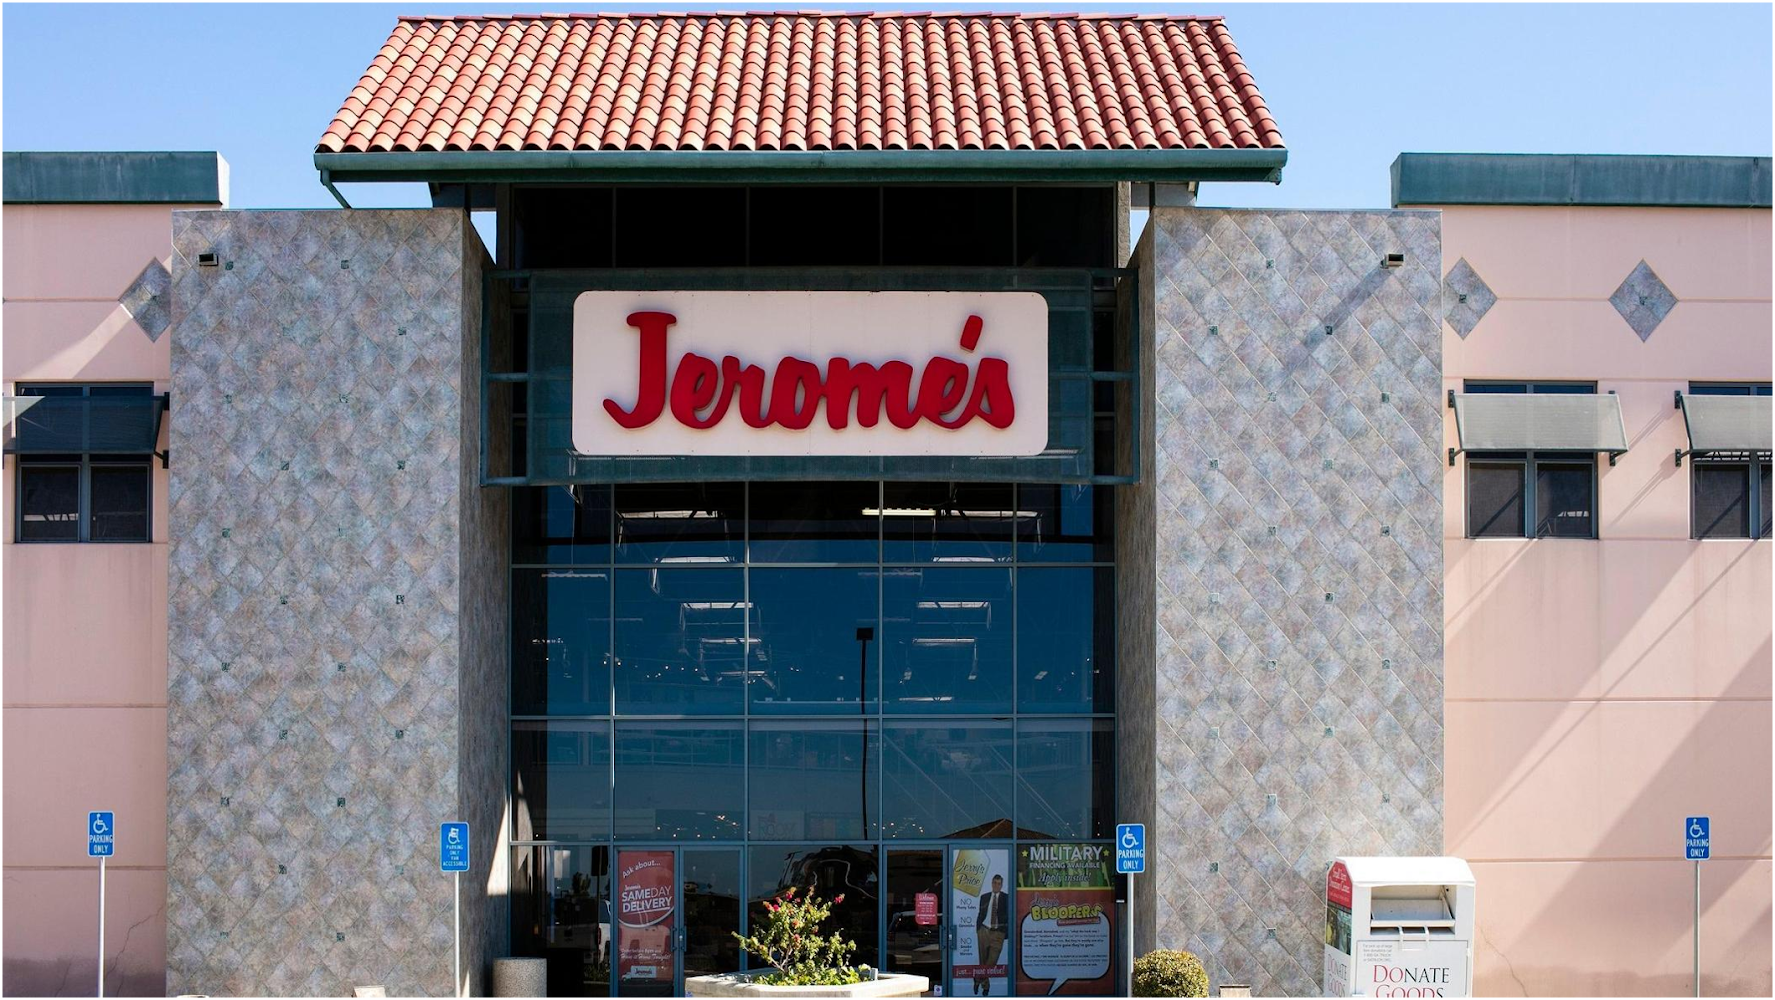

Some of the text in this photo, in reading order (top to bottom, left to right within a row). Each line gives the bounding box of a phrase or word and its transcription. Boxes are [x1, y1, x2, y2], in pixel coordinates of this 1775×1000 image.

[603, 311, 1015, 430] Jerome's
[90, 834, 113, 843] PARKING
[1686, 838, 1709, 847] PARKING
[93, 844, 108, 854] ONLY
[1030, 846, 1103, 861] MILITARY
[1118, 849, 1144, 859] PARKING
[1690, 848, 1705, 857] ONLY
[622, 859, 661, 879] Ask about...
[955, 859, 985, 874] Jerry's
[1123, 860, 1139, 870] ONLY
[958, 873, 981, 886] Price
[1038, 872, 1062, 885] Apply
[621, 885, 671, 902] SAMEDAY
[622, 896, 673, 913] DELIVERY
[1031, 904, 1103, 921] BLOOPERS
[960, 916, 972, 924] NO
[1328, 954, 1347, 981] DONATE
[1373, 964, 1450, 983] DONATE
[1375, 984, 1444, 998] GOODS
